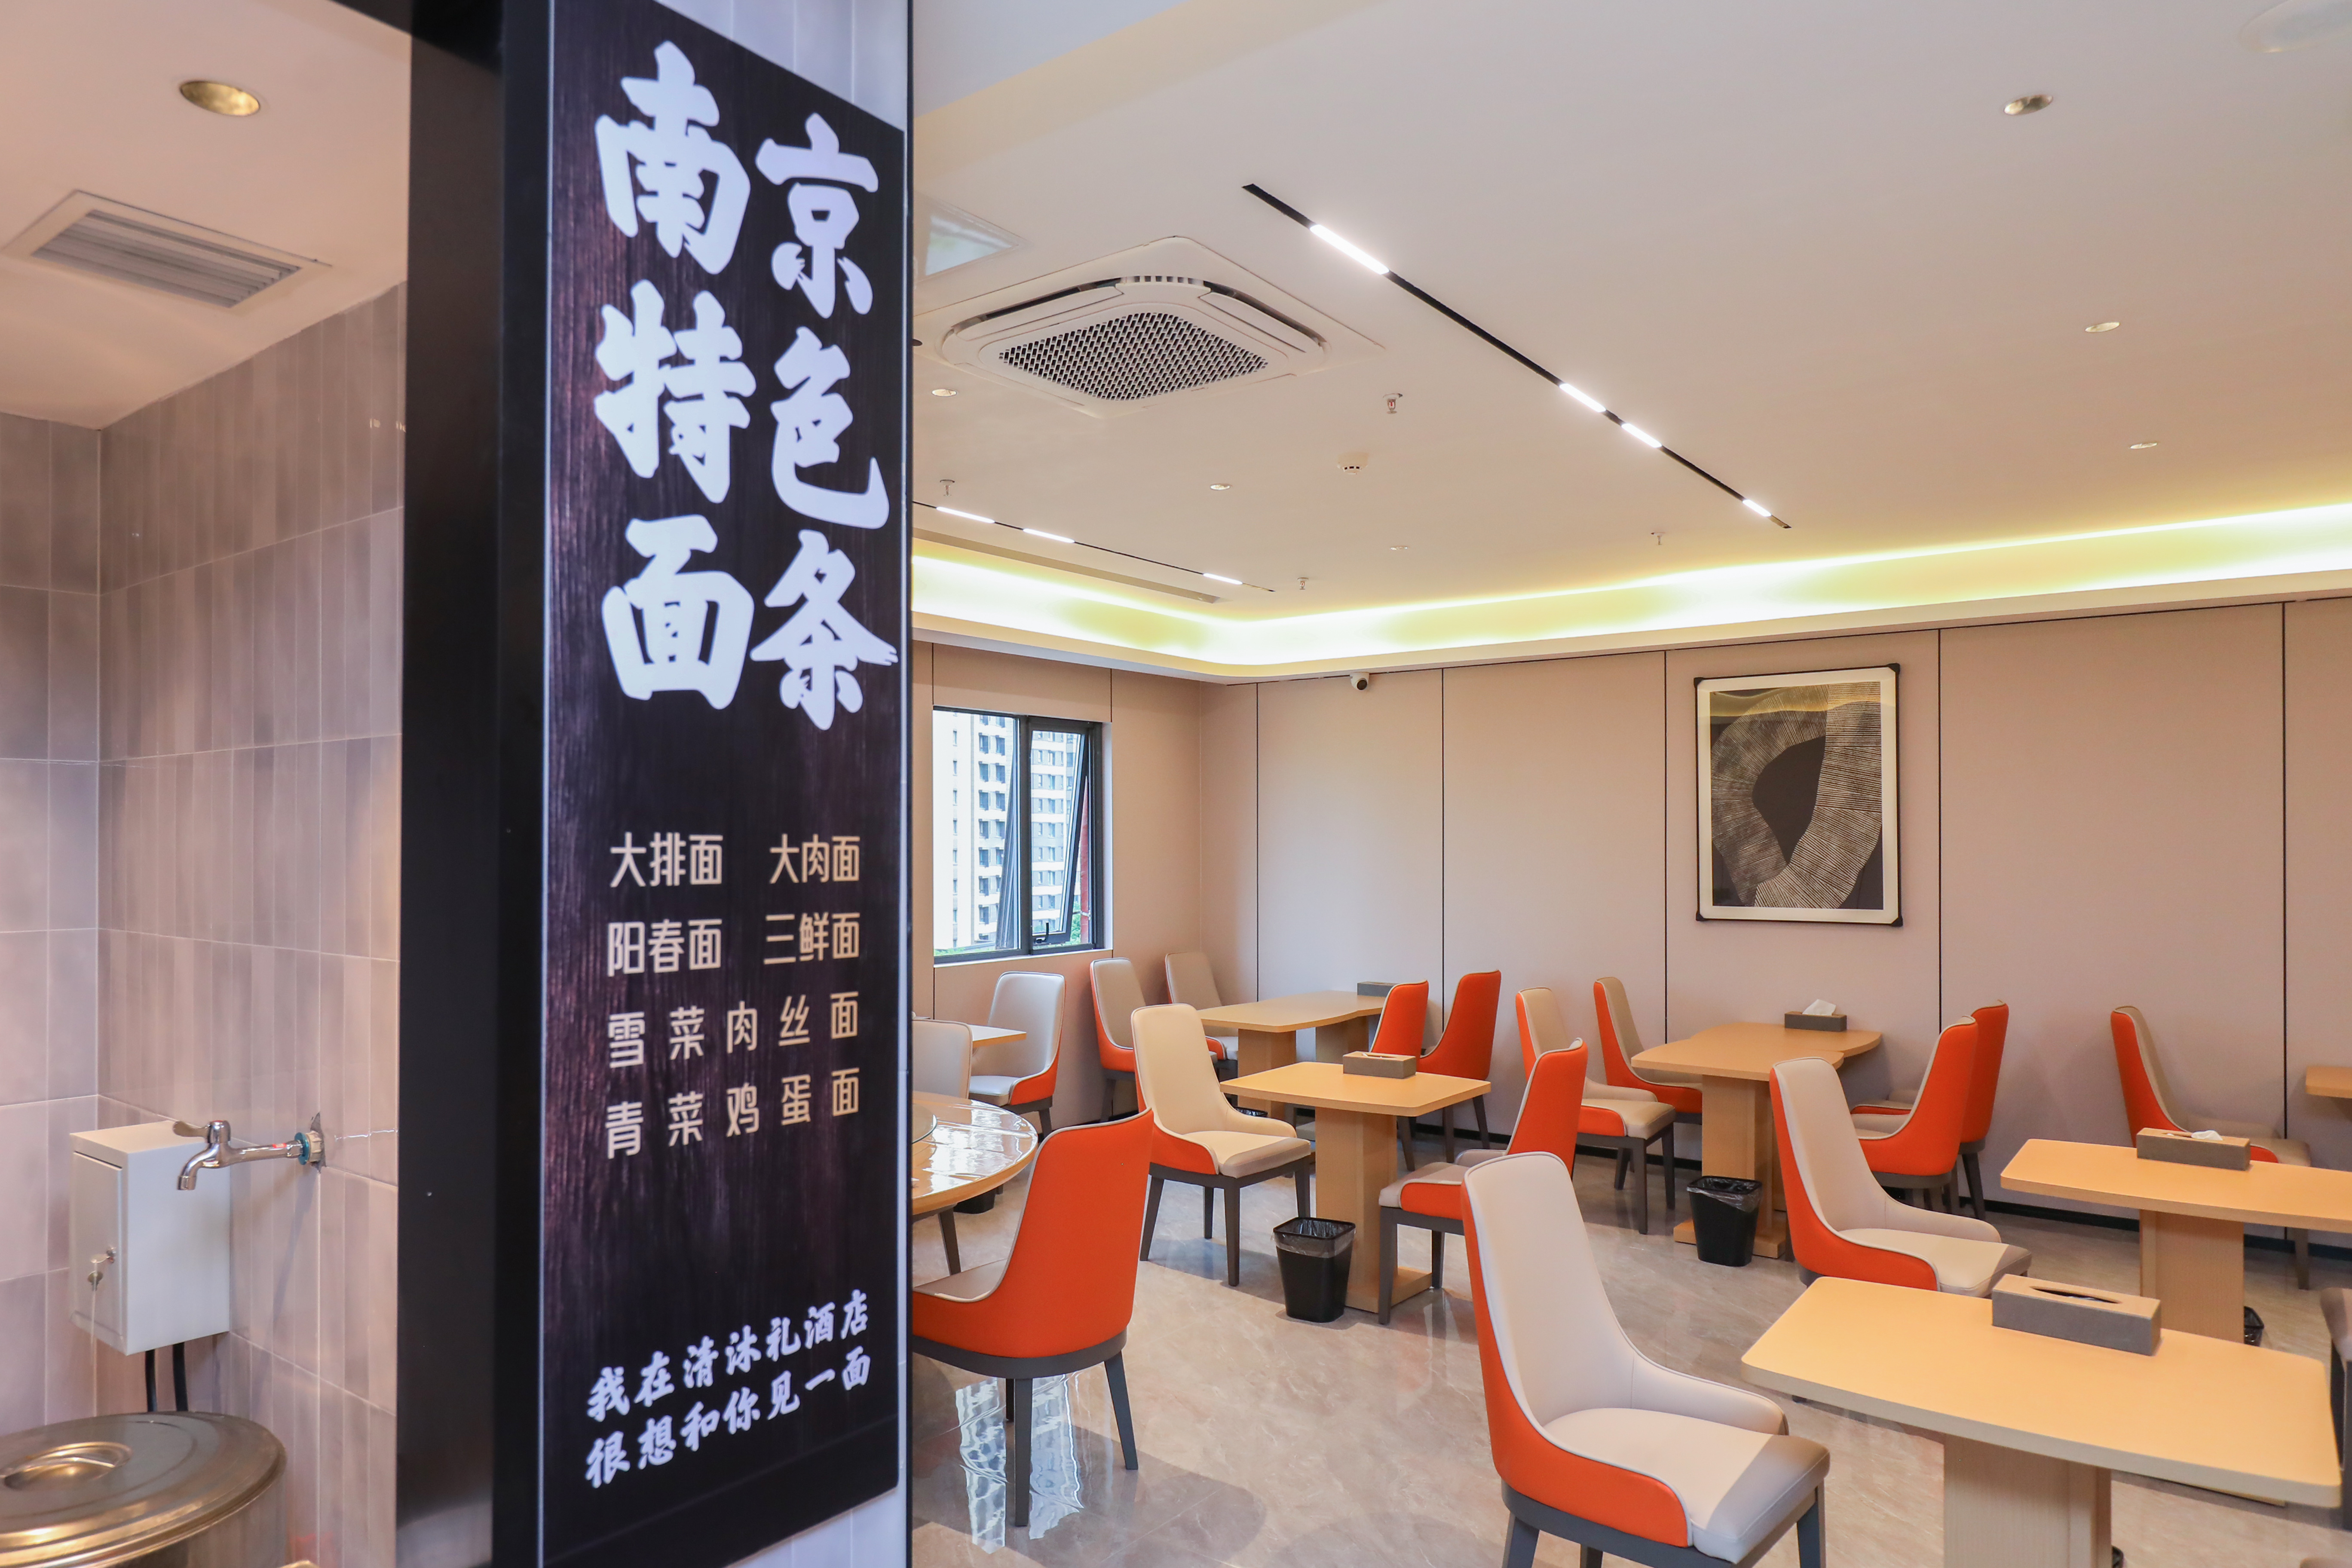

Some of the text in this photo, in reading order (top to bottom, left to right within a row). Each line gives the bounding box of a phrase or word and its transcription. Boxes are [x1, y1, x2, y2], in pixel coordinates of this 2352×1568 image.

[595, 41, 878, 318] 南京
[593, 280, 889, 529] 特色
[602, 515, 898, 730] 面条
[610, 832, 723, 888] 大排面
[770, 834, 860, 884] 大肉面
[607, 919, 722, 977] 阳春面
[764, 913, 860, 965] 三鲜面
[608, 992, 859, 1069] 雪菜肉丝面
[605, 1068, 859, 1159] 青菜鸡蛋面
[588, 1290, 868, 1421] 我在清沐礼酒店
[586, 1346, 870, 1488] 很想和你见一面
